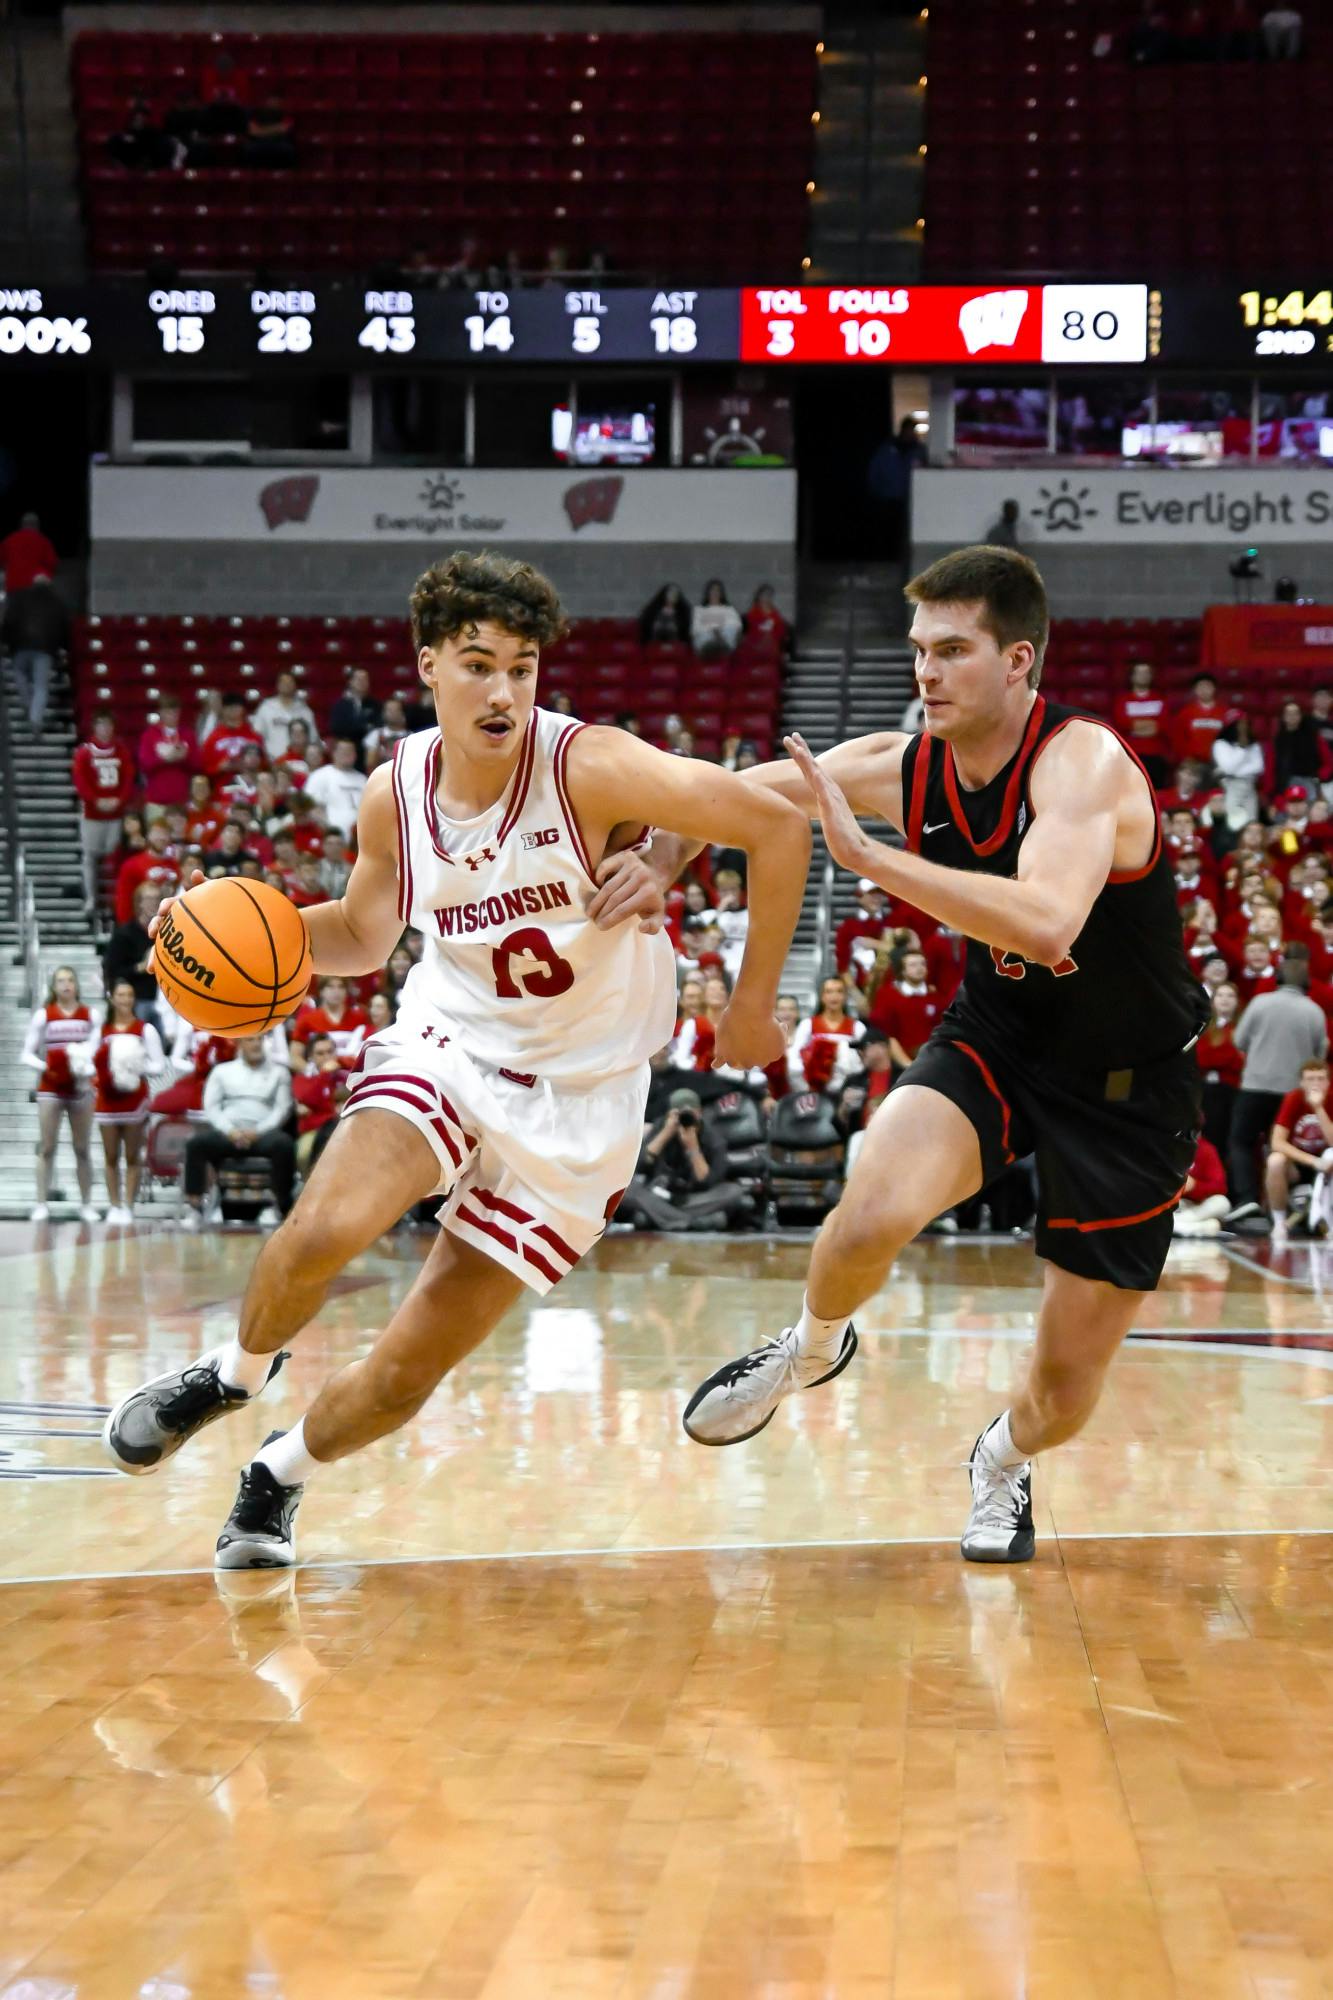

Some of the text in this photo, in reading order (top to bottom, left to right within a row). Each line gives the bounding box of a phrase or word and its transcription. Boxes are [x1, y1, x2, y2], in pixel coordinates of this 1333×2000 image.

[148, 291, 216, 313] OREB
[251, 291, 316, 313] DREB
[364, 291, 413, 313] REB
[474, 291, 509, 314] TO
[565, 291, 608, 314] STL
[650, 291, 698, 313] AST
[756, 291, 807, 314] TOL
[828, 290, 909, 314] FOULS
[1240, 290, 1333, 326] 1:44
[157, 317, 205, 353] 15
[257, 316, 313, 353] 28
[358, 317, 416, 353] 43
[464, 316, 514, 352] 14
[571, 317, 600, 353] 5
[650, 317, 697, 353] 18
[766, 320, 795, 356] 3
[840, 320, 891, 356] 10
[1062, 310, 1119, 341] 80
[1255, 330, 1316, 355] 2ND
[1117, 489, 1333, 532] Everlight S
[433, 880, 572, 938] WISCONSIN
